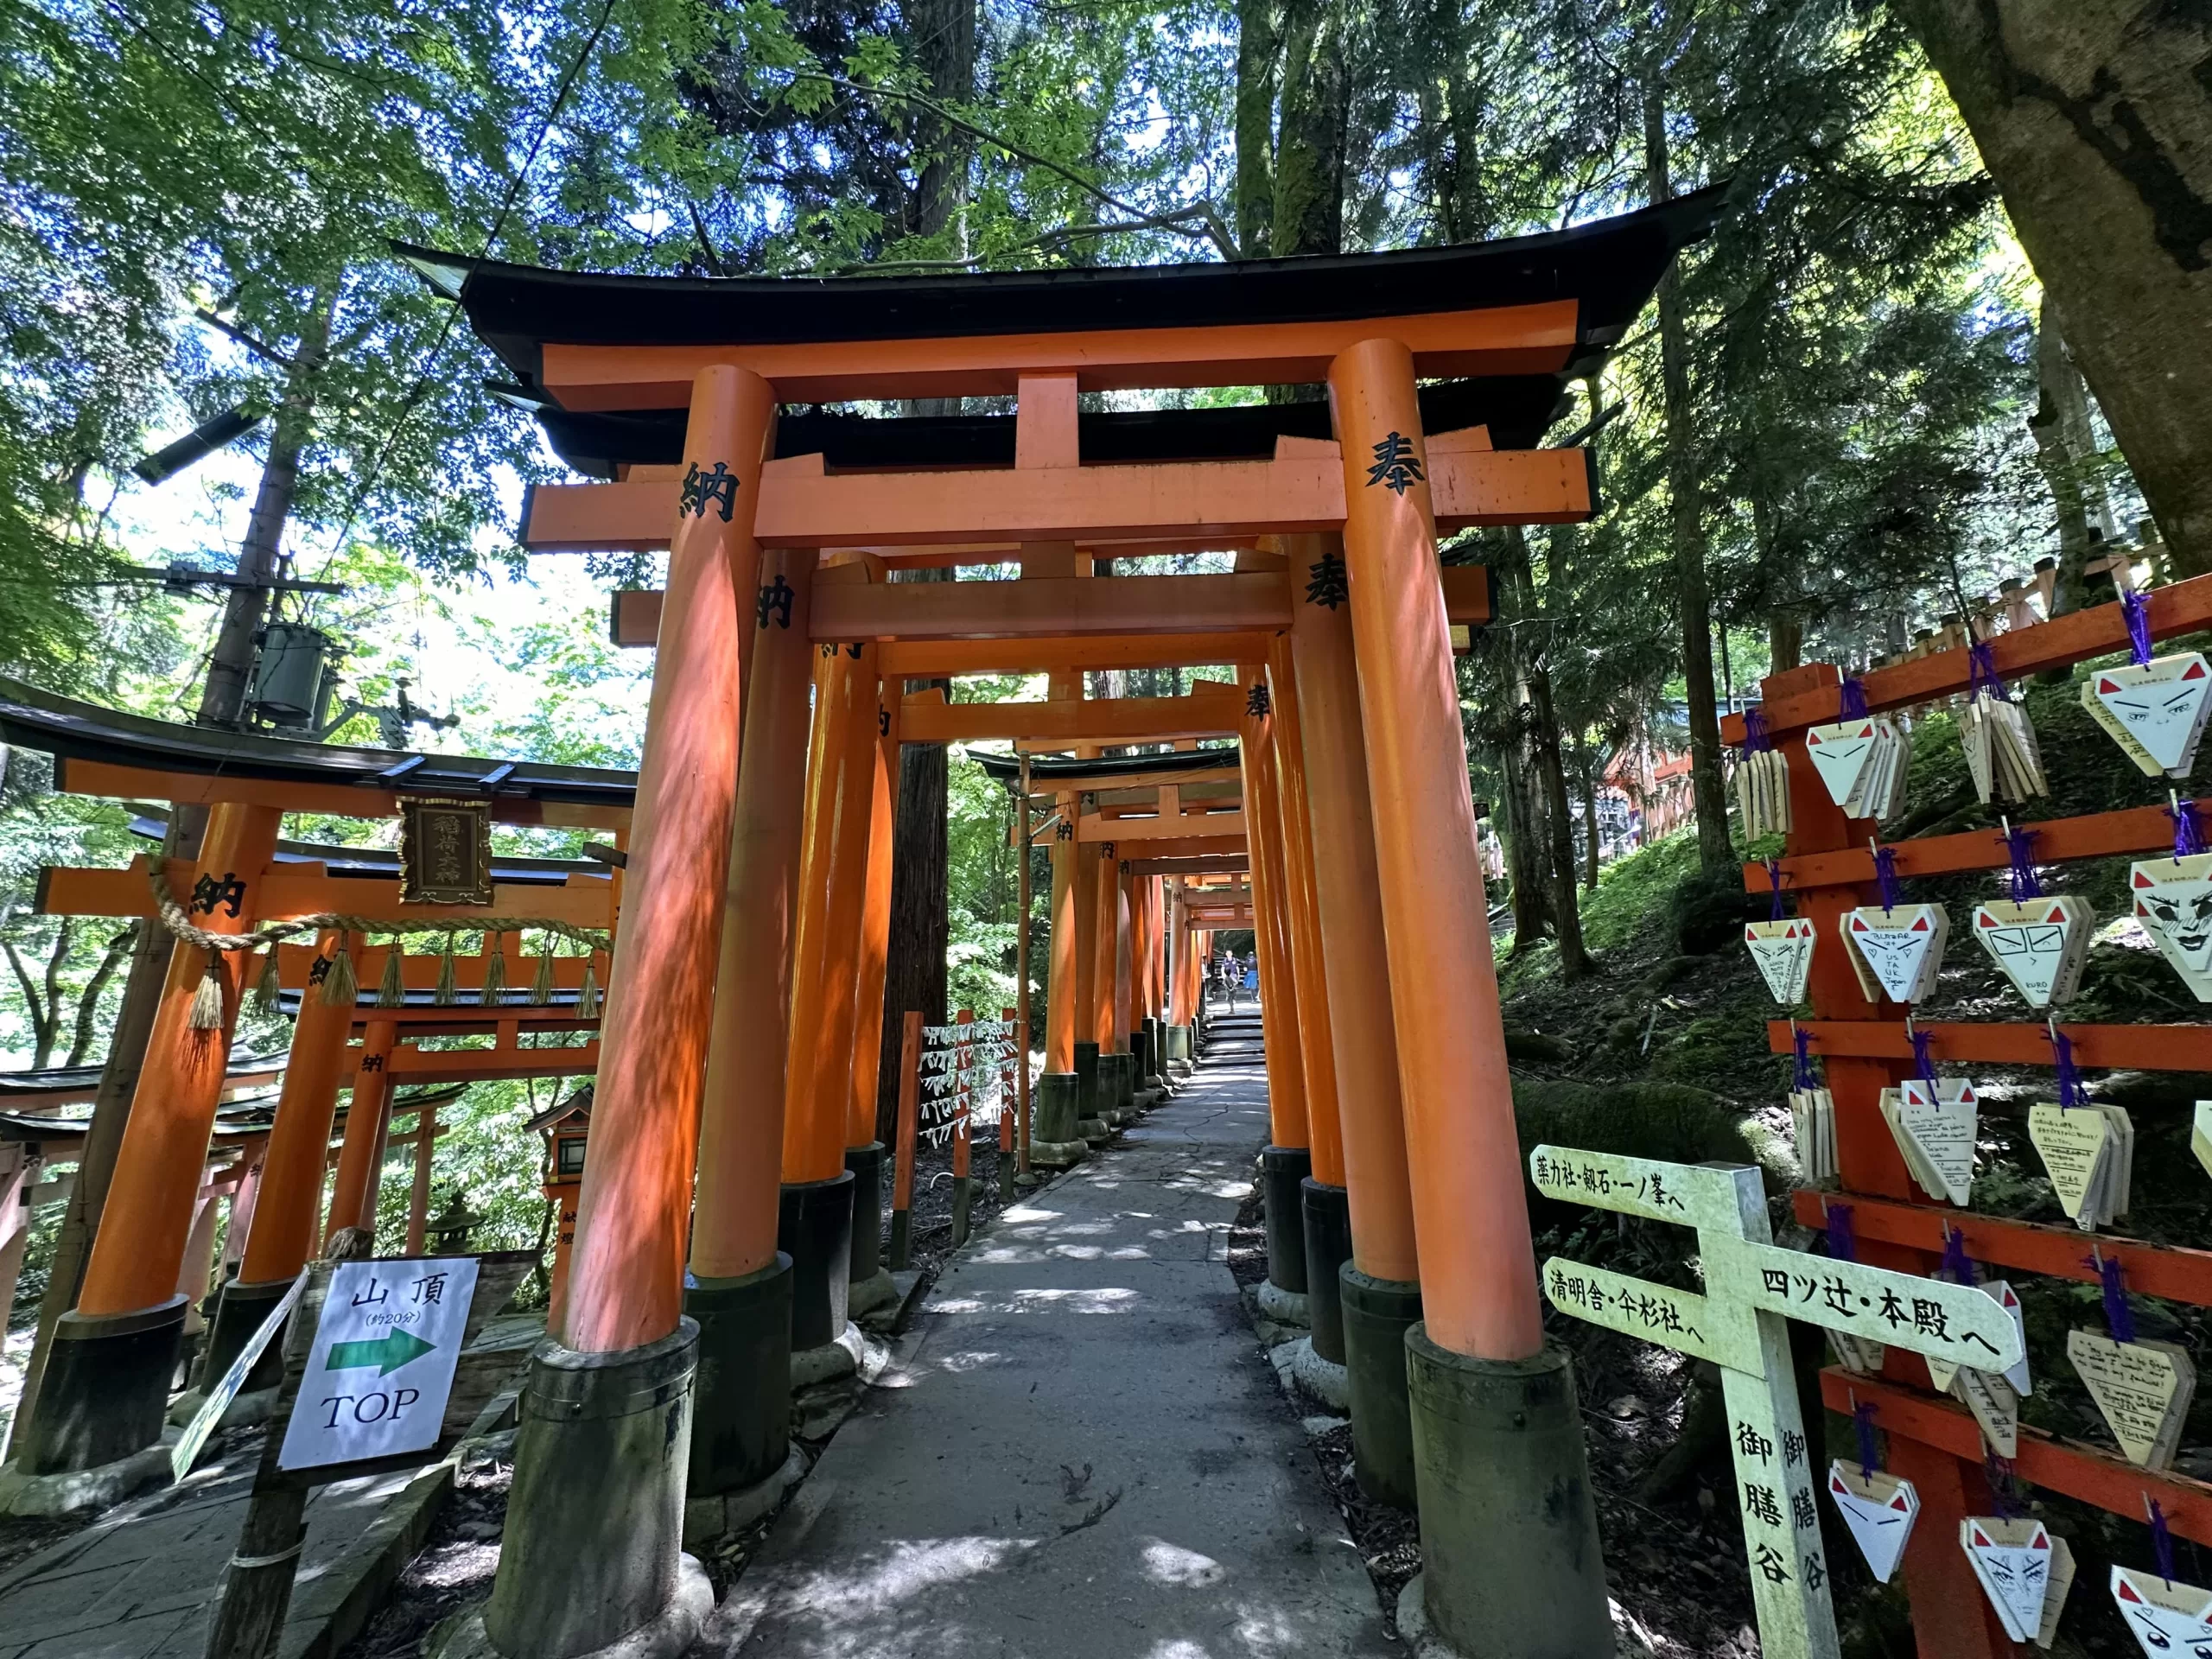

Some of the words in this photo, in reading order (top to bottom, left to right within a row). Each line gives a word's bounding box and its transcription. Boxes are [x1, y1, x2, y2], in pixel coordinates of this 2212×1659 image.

[679, 461, 741, 524] 納
[1365, 431, 1426, 498] 奉
[188, 872, 247, 918] 納
[361, 1053, 385, 1073] 納
[365, 1310, 422, 1326] (約20分)
[1760, 1268, 2001, 1357] 四ツ辻・本殿へ
[321, 1388, 421, 1429] TOP
[1735, 1420, 1794, 1586] 御膳谷
[1782, 1429, 1826, 1592] 御膳谷
